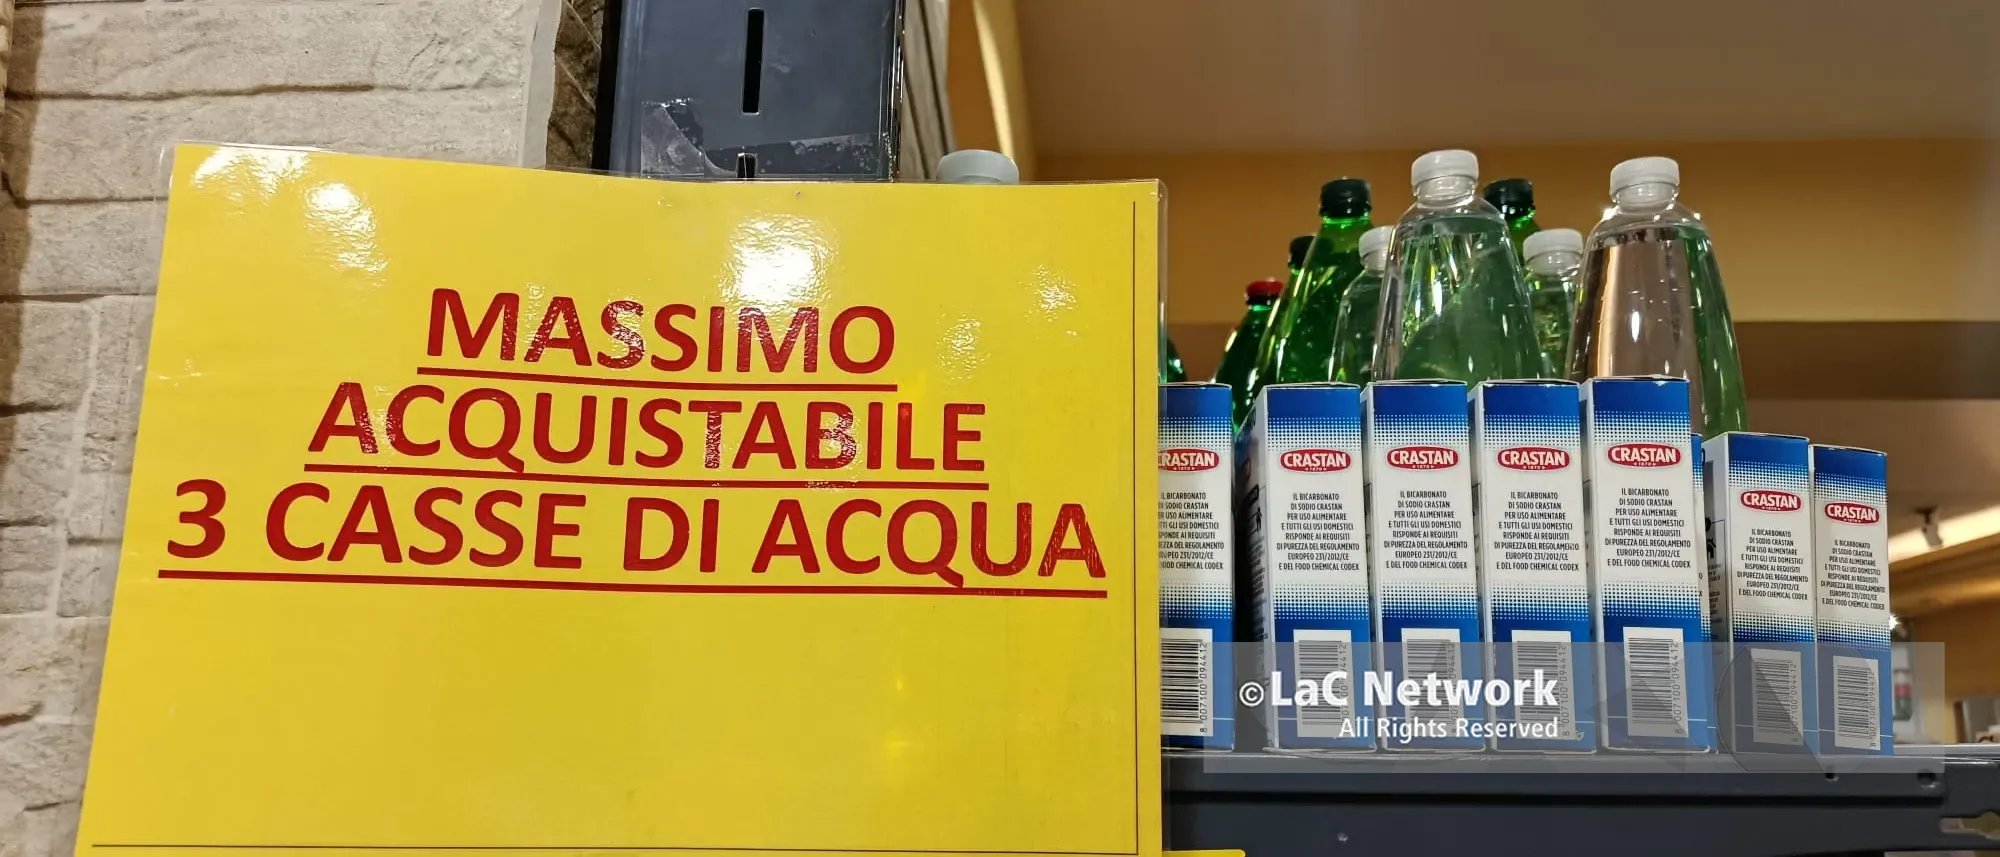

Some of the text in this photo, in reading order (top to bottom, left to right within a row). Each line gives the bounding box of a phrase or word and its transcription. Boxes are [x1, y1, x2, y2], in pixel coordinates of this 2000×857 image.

[427, 287, 897, 374] MASSIMO
[306, 381, 986, 475] ACQUISTABILE
[1391, 451, 1453, 465] CRASTAN
[1501, 451, 1565, 466] CRASTAN
[1611, 447, 1676, 462] CRASTAN
[1284, 453, 1346, 467] CRASTAN
[1628, 488, 1669, 496] BICARBONATO
[1627, 498, 1645, 506] SODIO
[1743, 493, 1797, 509] CRASTAN
[1628, 508, 1640, 516] USO
[1641, 508, 1677, 516] ALIMENTARE
[1827, 504, 1876, 521] CRASTAN
[1542, 522, 1573, 530] DOMESTICI
[1615, 518, 1631, 526] TUTTI
[1632, 518, 1641, 526] GLI
[1653, 519, 1684, 527] DOMESTICI
[168, 479, 1107, 586] 3 CASSE DI ACQUA
[1503, 532, 1569, 540] RISPONDE AI REQUISITI
[1614, 528, 1643, 536] RISPONDE
[1653, 529, 1680, 537] REQUISITI
[1605, 538, 1611, 546] DI
[1612, 538, 1638, 546] PUREZZA
[1650, 539, 1690, 547] REGOLAMENTO
[1506, 552, 1568, 560] EUROPEO 231/2012/CE
[1617, 549, 1680, 557] EUROPEO 231/2012/CE
[1501, 562, 1511, 570] DEL
[1513, 562, 1529, 570] FOOD
[1559, 563, 1579, 571] CODEX
[1612, 559, 1622, 567] DEL
[1624, 559, 1640, 567] FOOD
[1641, 559, 1670, 567] CHEMICAL
[1671, 560, 1691, 568] CODEX
